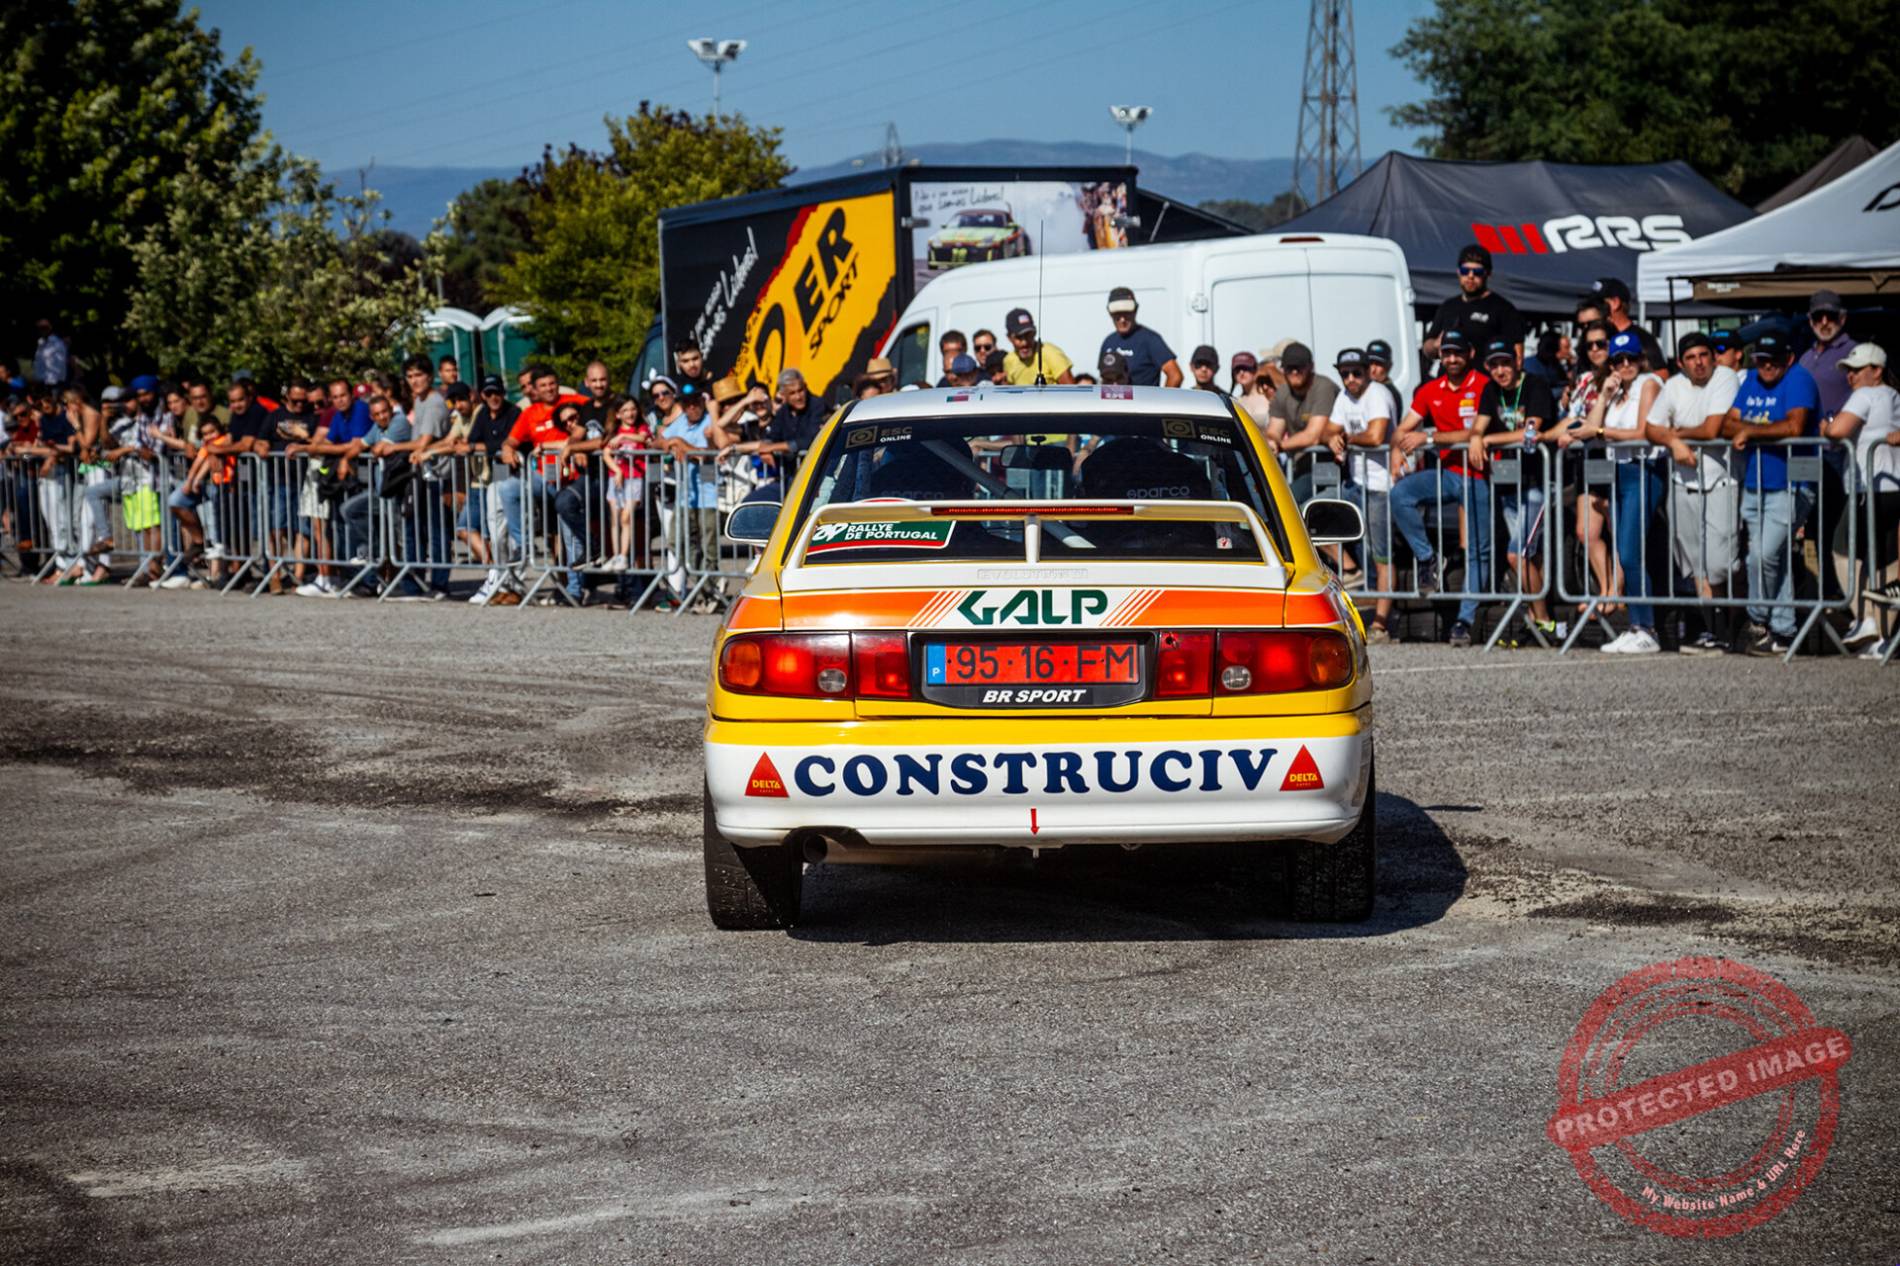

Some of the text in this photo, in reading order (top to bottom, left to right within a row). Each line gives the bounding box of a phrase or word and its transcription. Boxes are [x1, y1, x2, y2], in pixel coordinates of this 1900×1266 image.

[1543, 214, 1694, 253] RRS
[810, 252, 859, 360] SPORT
[880, 434, 912, 443] ONLINE
[1200, 434, 1232, 444] ONLINE
[848, 524, 893, 532] RALLYE
[845, 531, 938, 540] DE PORTUGAL
[957, 590, 1108, 624] GALP
[932, 668, 940, 678] P
[983, 689, 1087, 703] BR SPORT
[794, 748, 1277, 797] CONSTRUCIV
[1289, 773, 1318, 783] DELTA
[752, 780, 781, 790] DELTA
